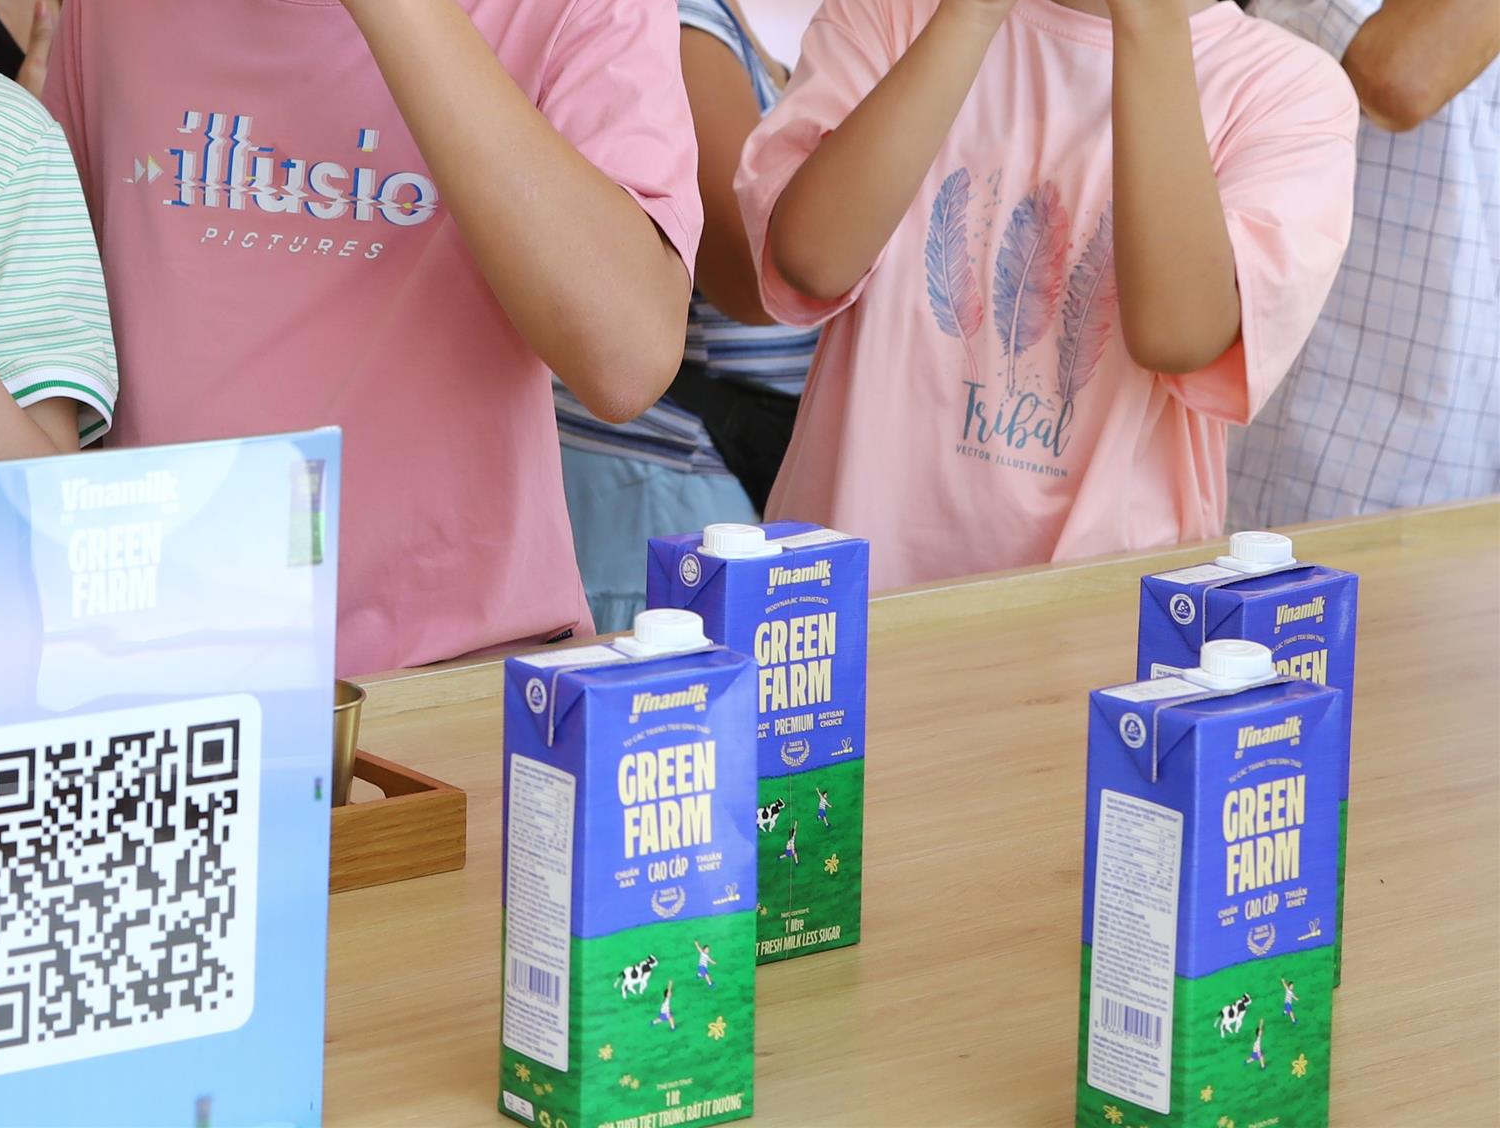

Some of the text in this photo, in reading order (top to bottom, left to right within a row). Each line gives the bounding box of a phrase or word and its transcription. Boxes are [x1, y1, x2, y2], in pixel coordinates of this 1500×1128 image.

[201, 227, 385, 260] PICTURES
[962, 380, 1074, 458] Tribal
[956, 443, 1069, 478] VECTOR ILLUSTRATION
[60, 470, 179, 511] Vinamilk
[67, 521, 163, 573] GREEN
[768, 559, 833, 587] Vinamilk
[71, 565, 157, 618] FARM
[1276, 595, 1326, 625] Vinamilk
[754, 612, 837, 667] GREEN
[632, 683, 709, 714] Vinamilk
[758, 659, 832, 713] FARM
[774, 713, 814, 736] PREMIUM
[818, 709, 845, 721] ARTISAN
[820, 718, 842, 728] CHOICE
[1237, 715, 1302, 749] Vinamilk
[618, 740, 717, 806] GREEN
[623, 793, 712, 859] FARM
[1222, 775, 1306, 844] GREEN
[647, 861, 668, 883] CAO
[1226, 828, 1300, 897] FARM
[1244, 898, 1261, 920] CAO
[760, 937, 783, 955] FRESH
[783, 933, 802, 951] MILK
[802, 929, 819, 946] LESS
[819, 925, 841, 944] SUGAR
